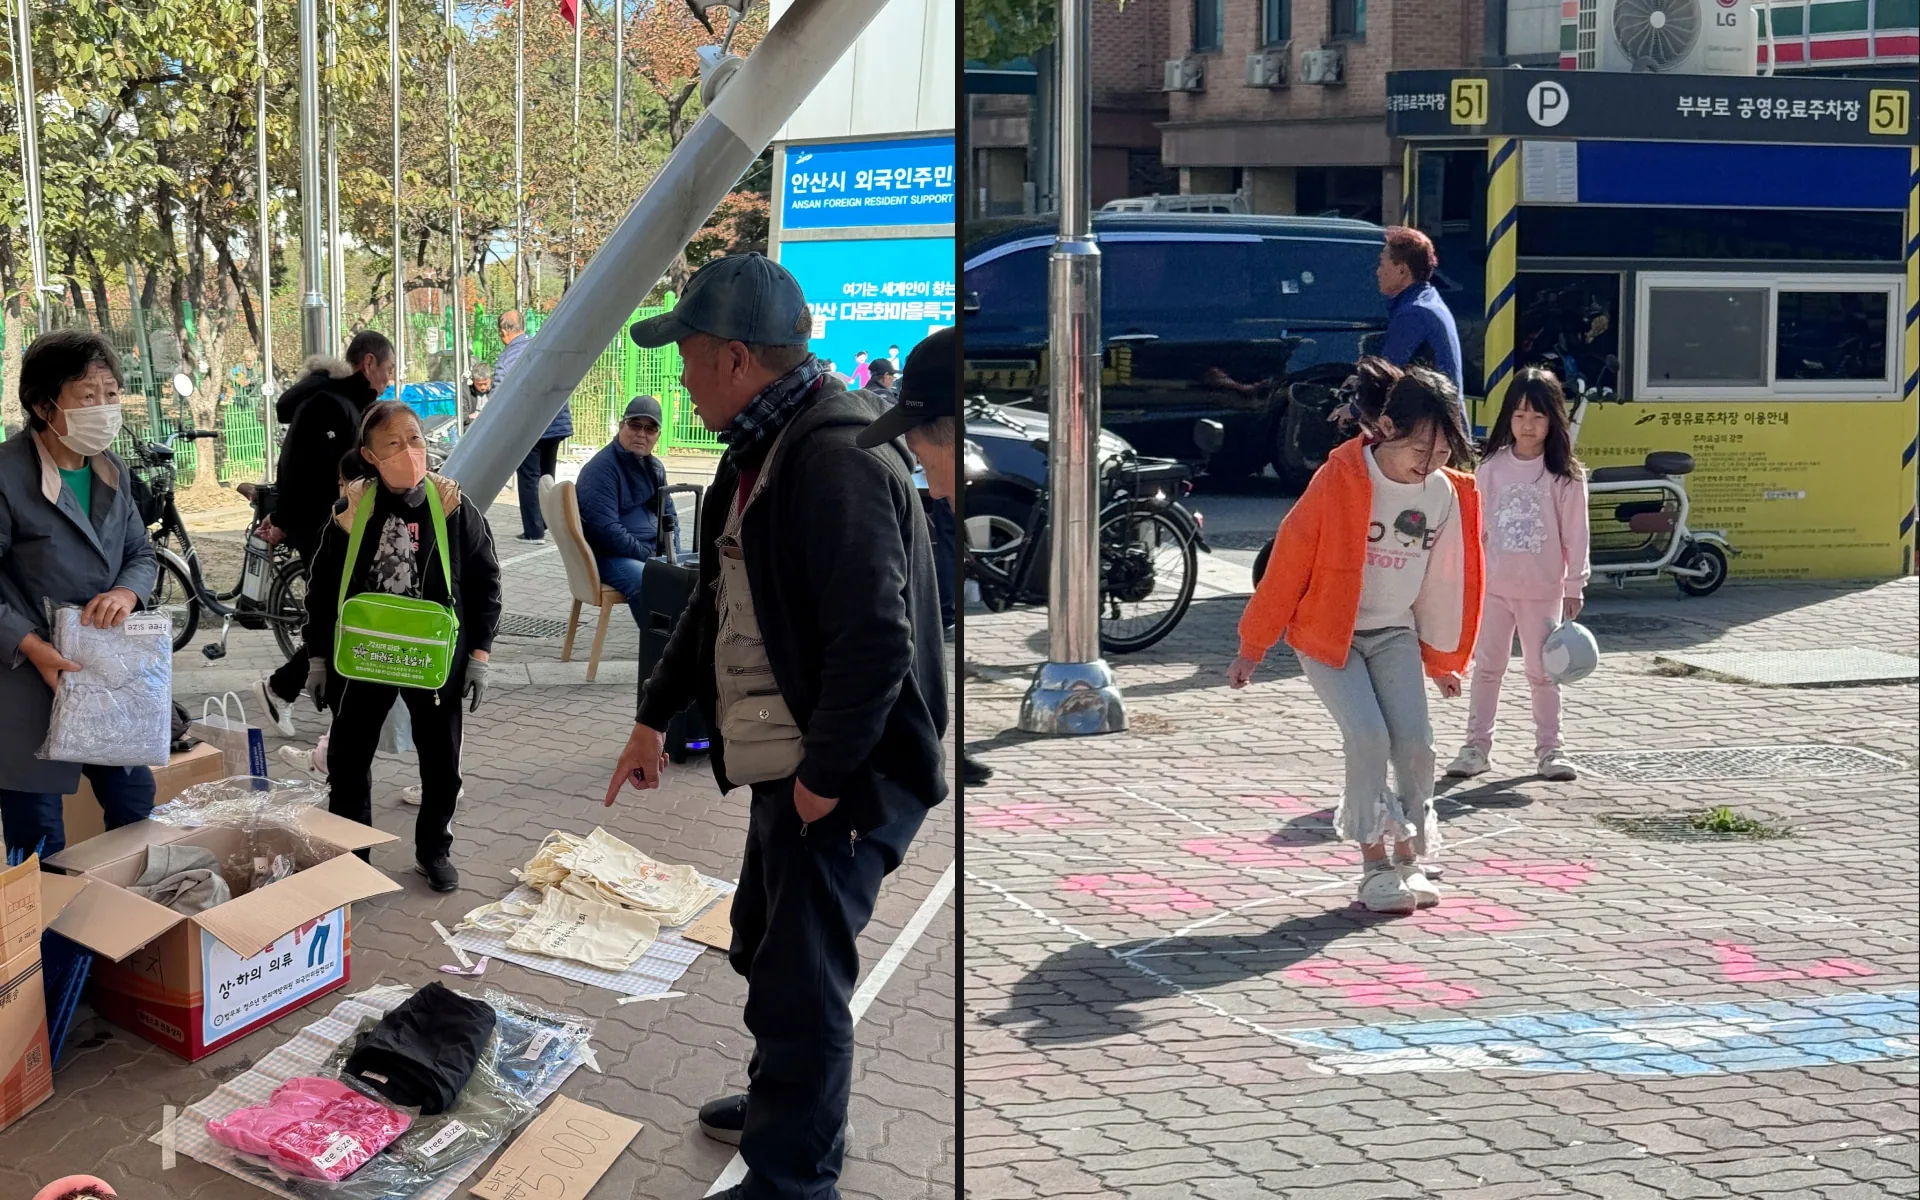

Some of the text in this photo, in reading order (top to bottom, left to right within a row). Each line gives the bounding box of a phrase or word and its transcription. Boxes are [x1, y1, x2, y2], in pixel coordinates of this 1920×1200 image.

[1716, 13, 1737, 27] LG
[1456, 85, 1483, 119] 51
[1537, 86, 1561, 121] P
[1676, 96, 1861, 122] 부부로 공영유료주차장
[1874, 95, 1905, 129] 51
[791, 165, 955, 194] 안산시 외국인주민
[791, 193, 953, 209] ANSAN FOREIGN RESIDENT SUPPORT
[842, 281, 879, 297] 여기는
[880, 280, 930, 296] 세계인이
[840, 301, 955, 321] 다문화마을특구
[905, 399, 924, 408] SPORTS
[1659, 411, 1789, 426] 공영유료주차장 이용안내
[1366, 552, 1408, 570] YOU
[268, 952, 294, 972] 의류
[243, 997, 260, 1012] 청소년
